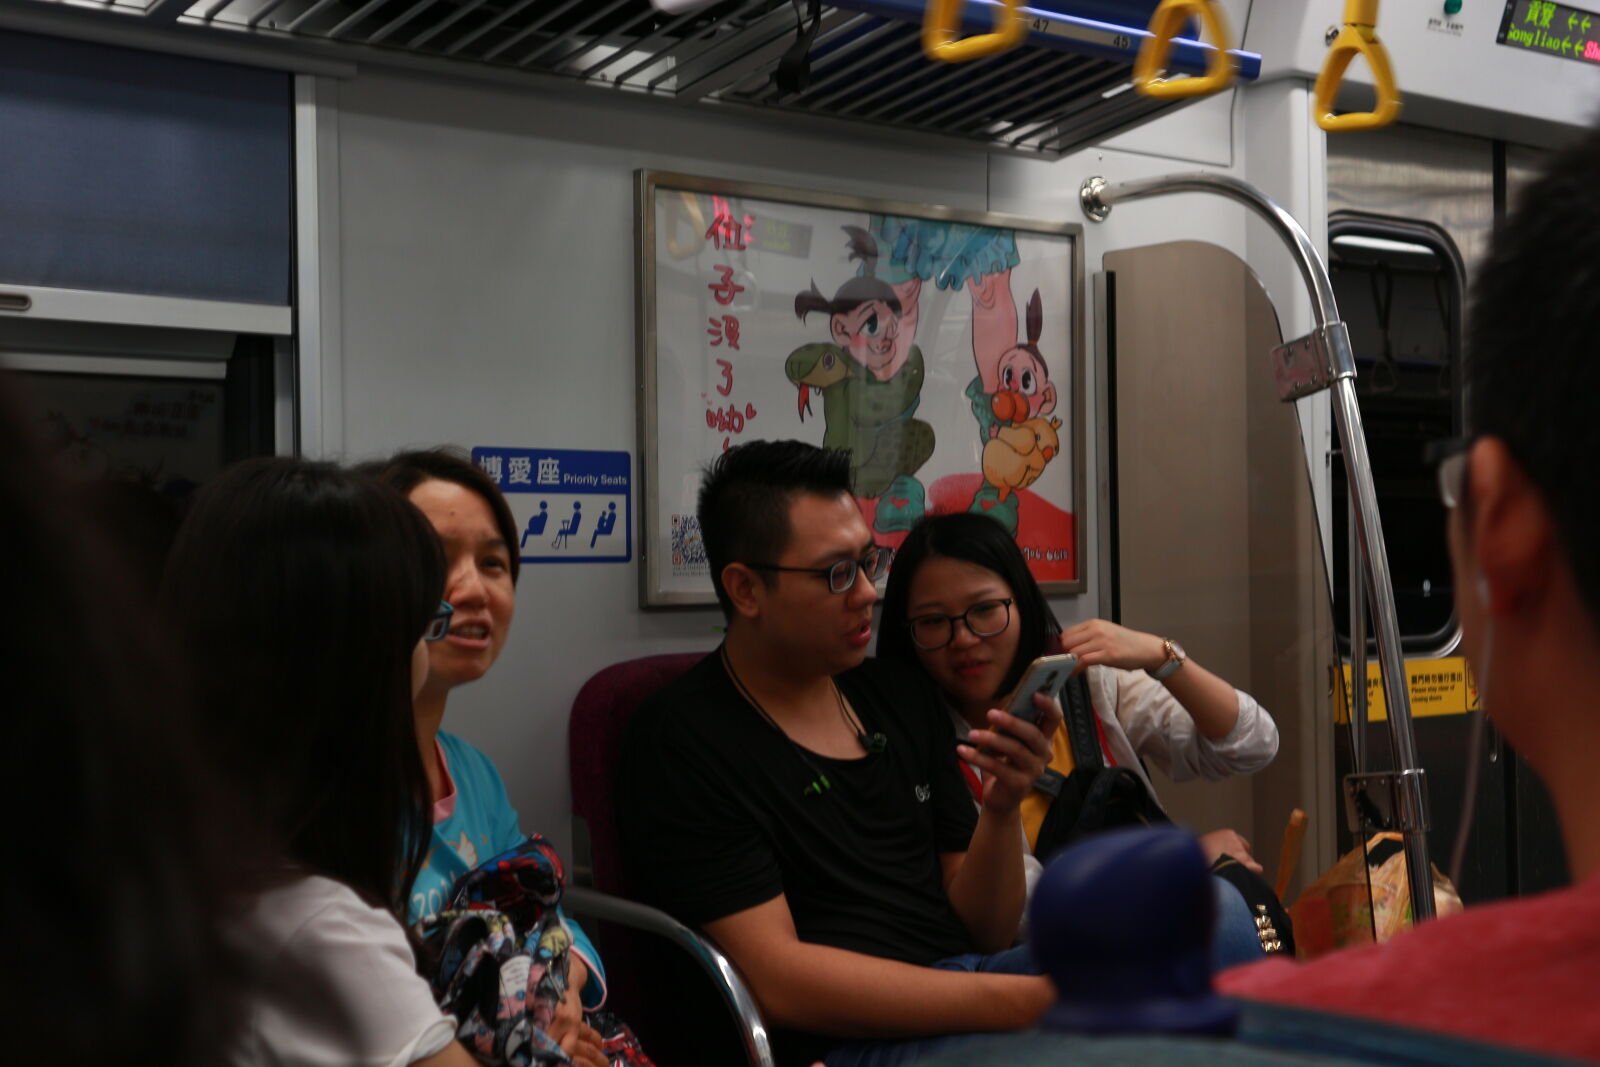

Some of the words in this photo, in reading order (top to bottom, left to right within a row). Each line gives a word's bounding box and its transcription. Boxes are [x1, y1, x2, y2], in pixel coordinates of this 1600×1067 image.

[1033, 18, 1049, 32] 47
[1113, 35, 1129, 49] 45
[1584, 40, 1600, 62] Sh
[478, 455, 561, 486] 博愛座
[563, 473, 598, 487] Priority
[601, 474, 627, 486] Seats
